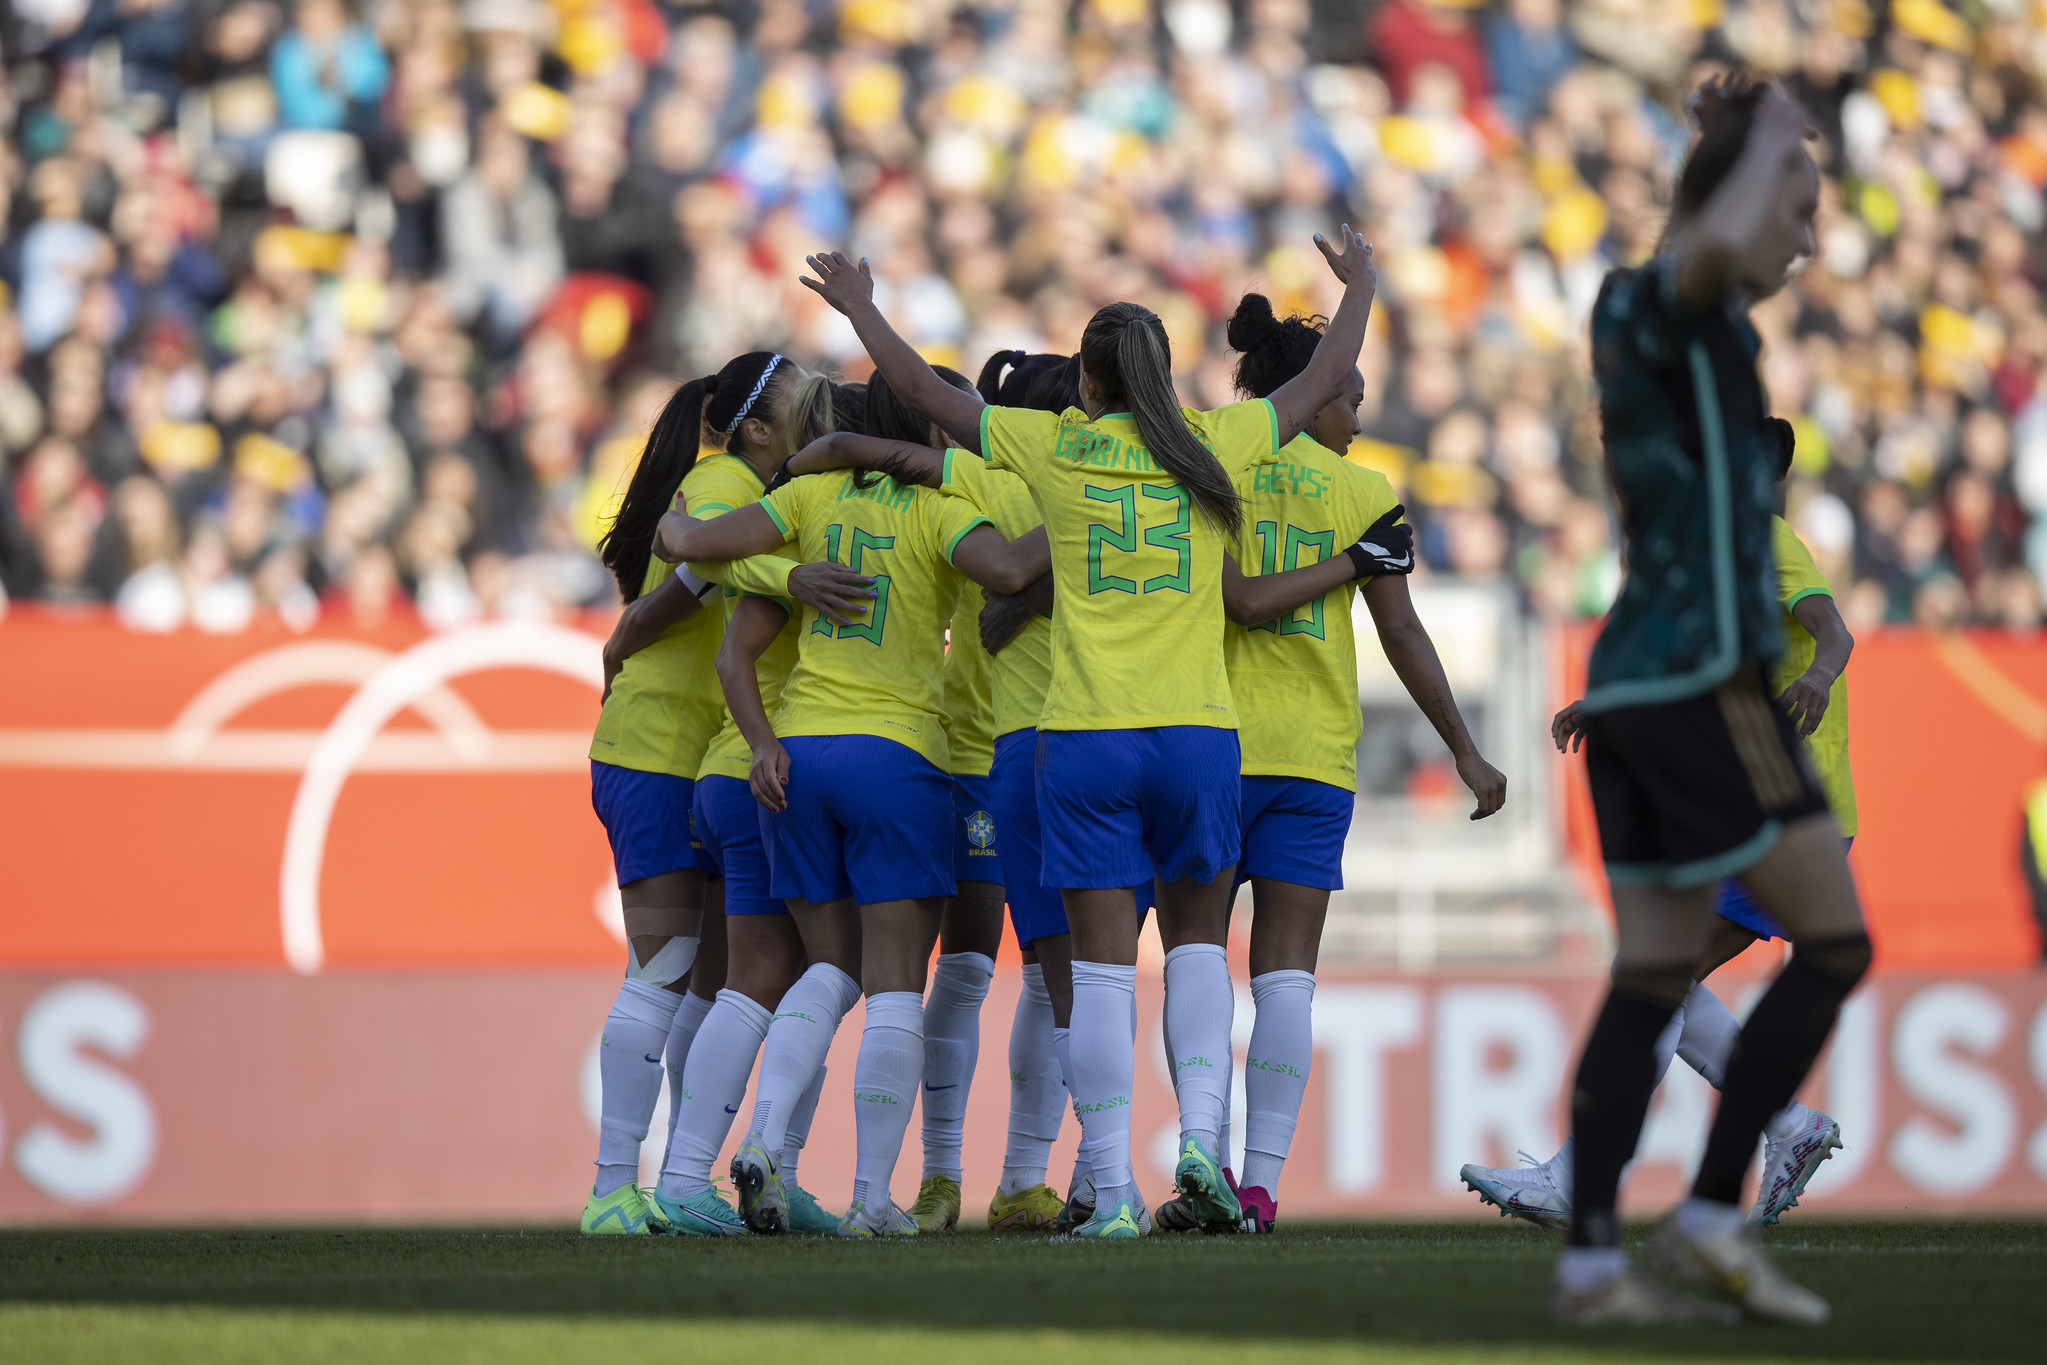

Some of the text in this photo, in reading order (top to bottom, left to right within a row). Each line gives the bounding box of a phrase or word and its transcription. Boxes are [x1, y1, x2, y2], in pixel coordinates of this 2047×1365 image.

[1054, 425, 1122, 468] GABI
[811, 523, 896, 647] 15
[1085, 483, 1191, 595] 23
[1247, 520, 1335, 641] 10
[968, 848, 997, 857] BRASIL
